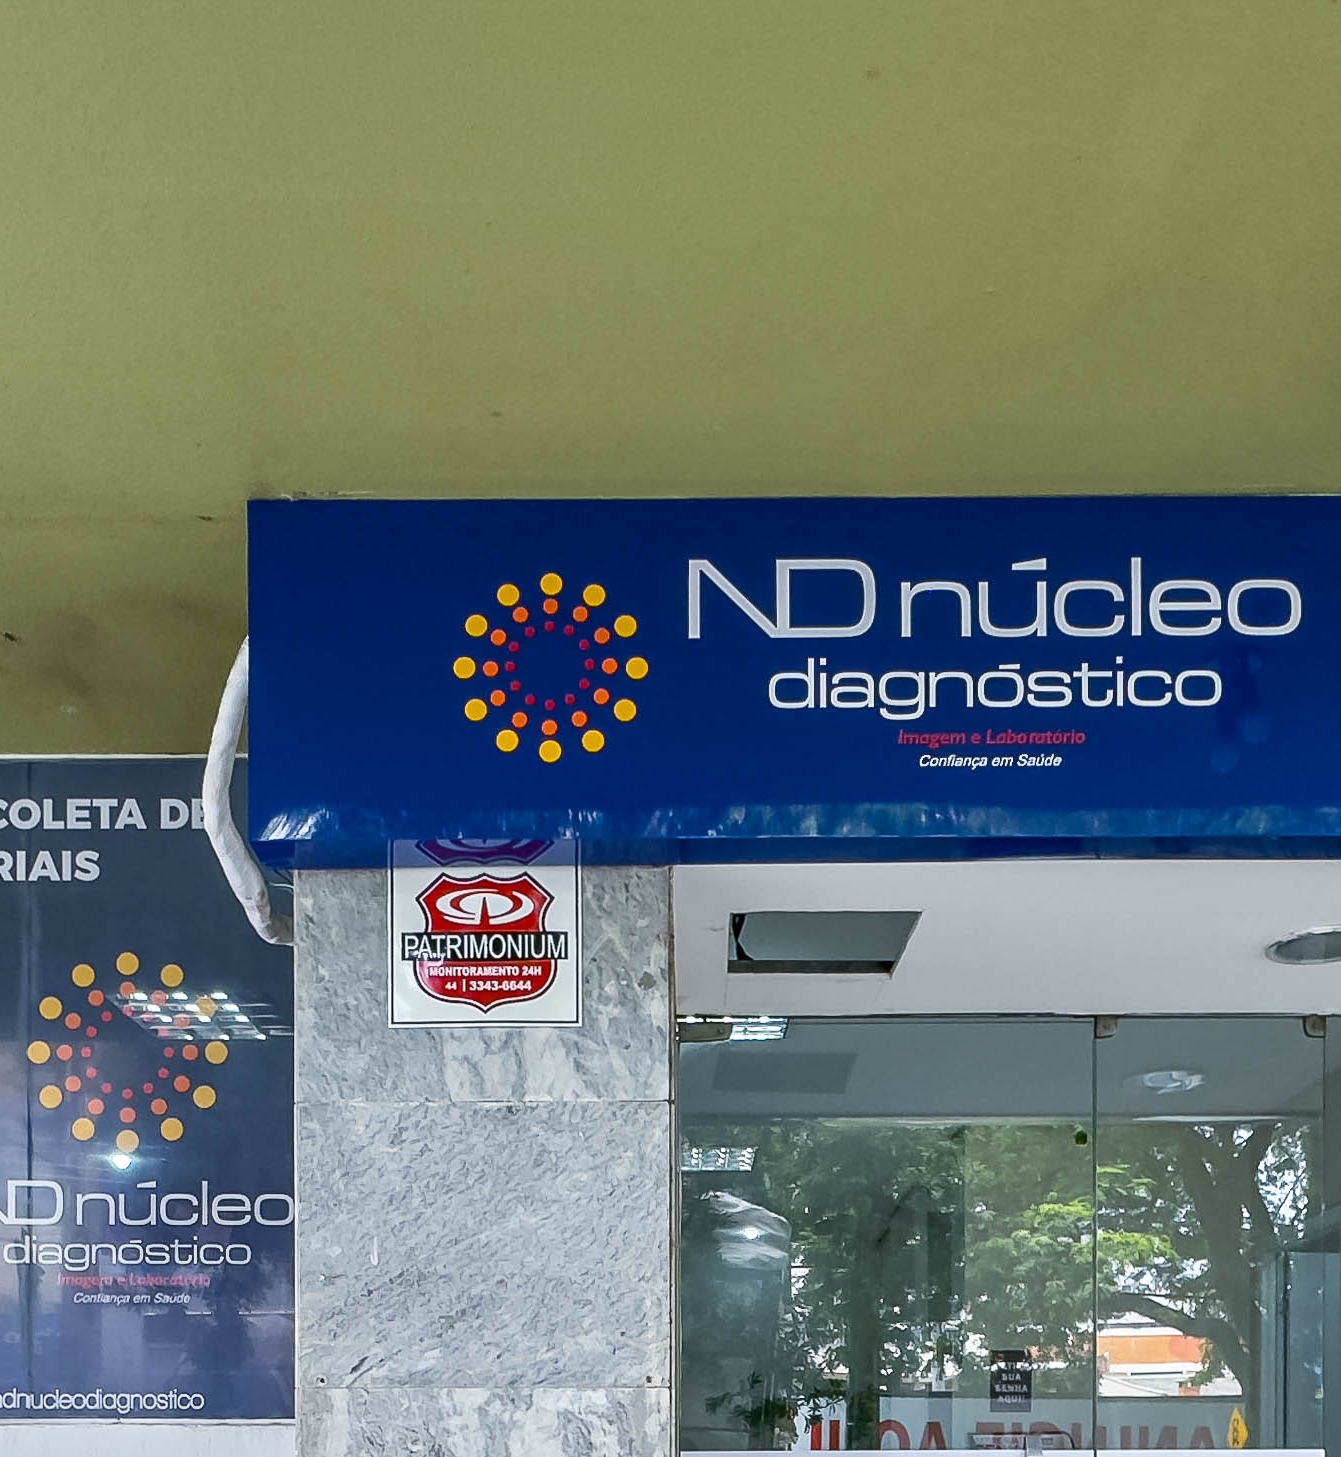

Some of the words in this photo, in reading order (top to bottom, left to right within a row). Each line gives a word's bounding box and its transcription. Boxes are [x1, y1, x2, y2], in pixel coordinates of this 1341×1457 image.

[688, 558, 877, 639] ND
[900, 556, 1304, 638] núcleo
[768, 655, 1223, 721] diagnóstico
[897, 728, 966, 749] Imagem
[970, 733, 982, 745] e
[986, 728, 1086, 745] Laboratório
[919, 754, 988, 771] Confiança
[991, 757, 1013, 767] em
[1017, 752, 1062, 767] Saúde
[404, 934, 566, 959] PATRIMONIUM
[428, 967, 519, 977] MONITORAMENTO
[522, 966, 542, 977] 24H
[77, 1180, 294, 1226] núcleo
[3, 1235, 252, 1272] diagnóstico
